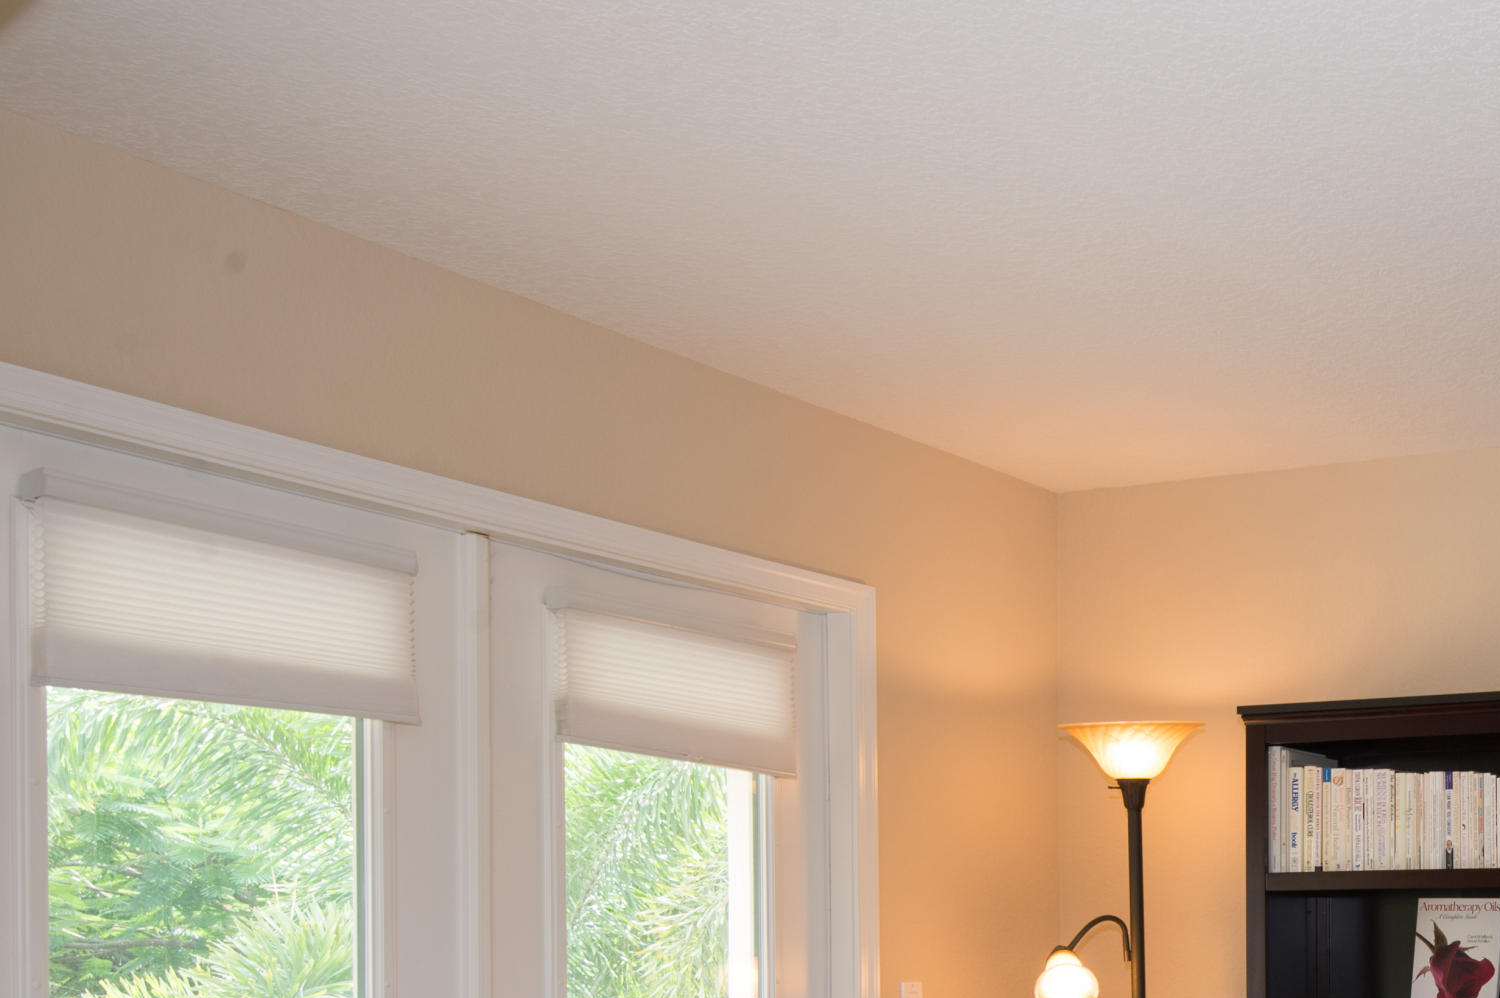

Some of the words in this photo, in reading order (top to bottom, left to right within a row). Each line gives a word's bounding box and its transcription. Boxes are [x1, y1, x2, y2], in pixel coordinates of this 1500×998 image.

[1291, 778, 1299, 812] ALLERGY
[1420, 902, 1483, 915] Aromatherapy
[1484, 901, 1500, 912] Oils
